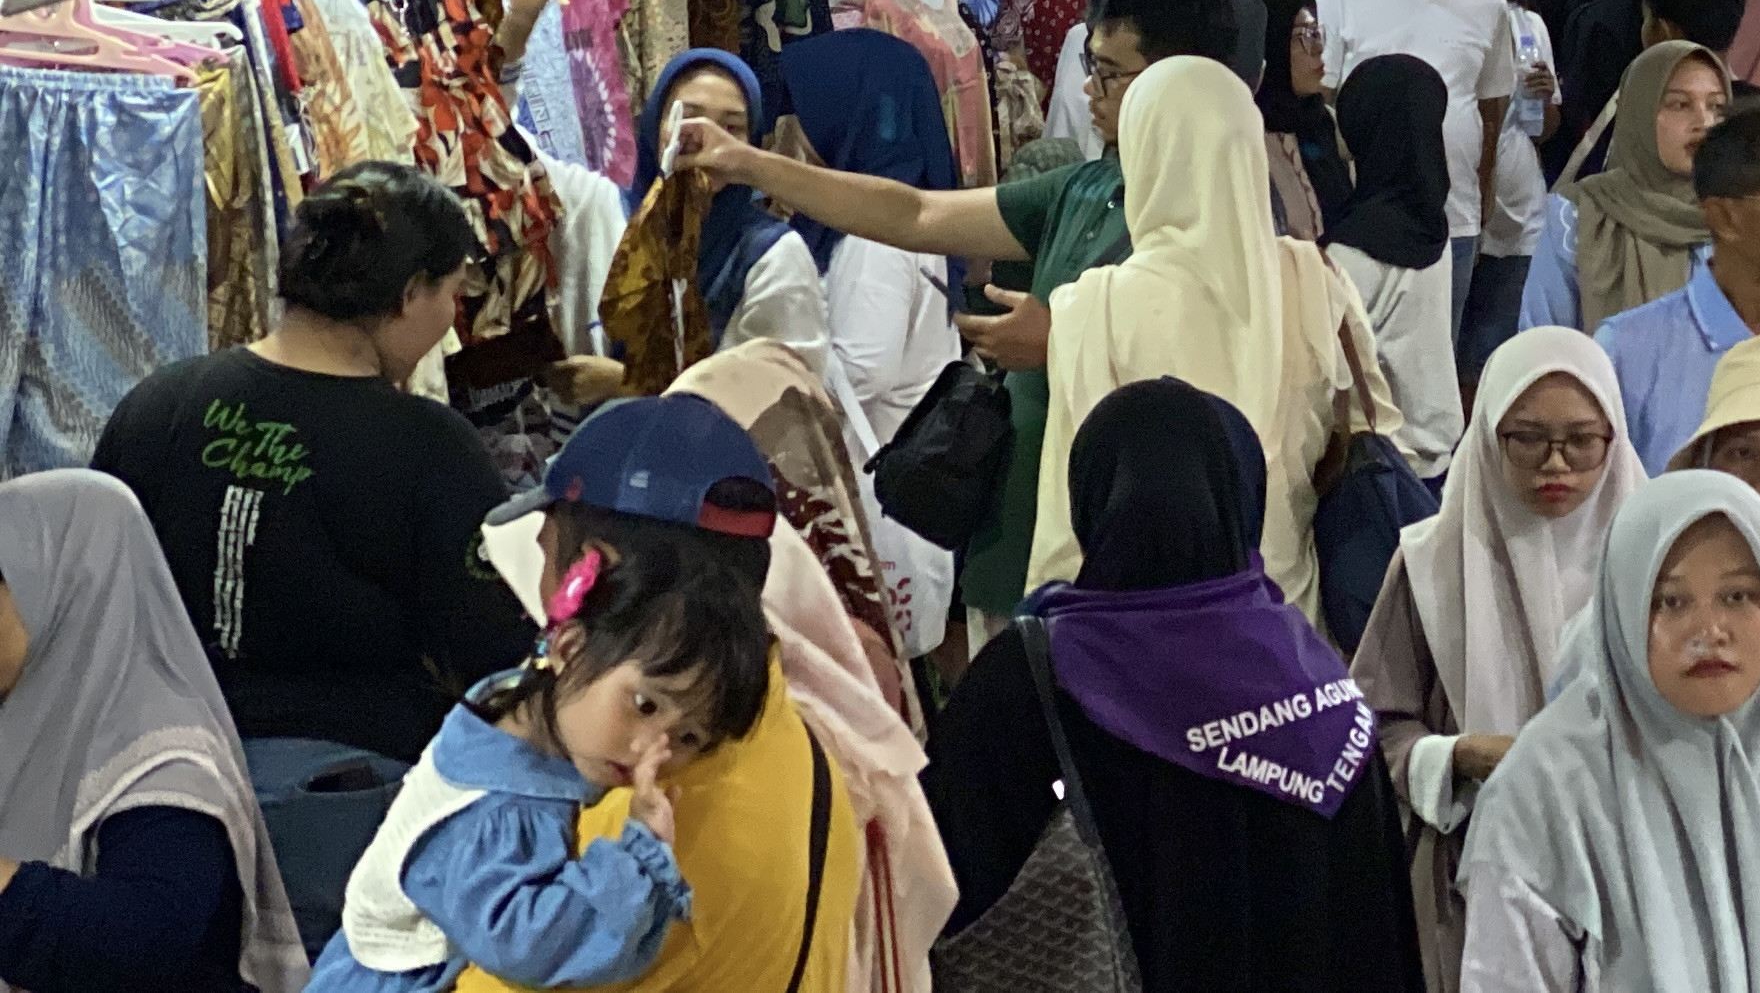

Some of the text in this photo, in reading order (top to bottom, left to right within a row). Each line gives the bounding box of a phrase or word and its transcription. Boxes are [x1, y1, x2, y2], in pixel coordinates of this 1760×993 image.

[203, 398, 312, 466] We The
[202, 437, 316, 496] Champ
[1186, 678, 1365, 753] SENDANG AGUN
[1217, 745, 1326, 804] LAMPUNG
